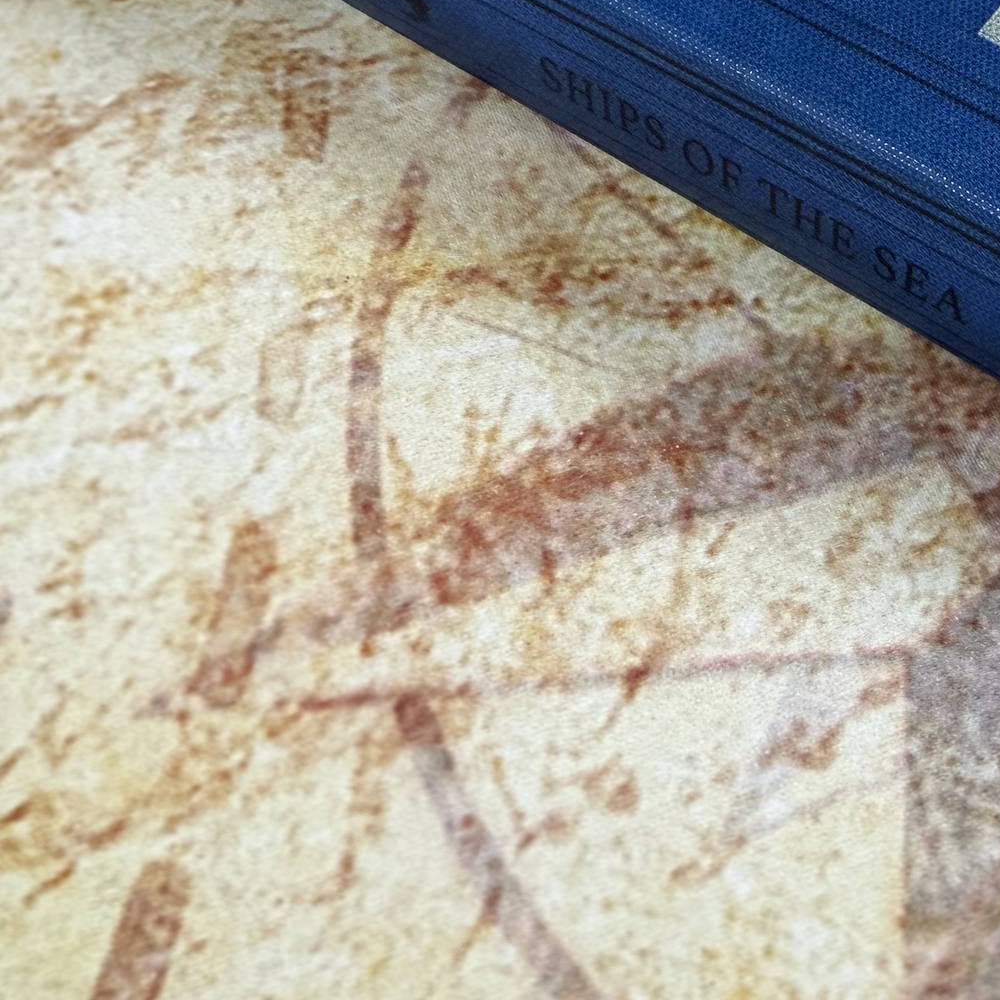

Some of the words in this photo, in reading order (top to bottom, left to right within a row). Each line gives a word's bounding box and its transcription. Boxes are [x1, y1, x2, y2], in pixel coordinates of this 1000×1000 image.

[538, 56, 667, 152] SHIPS
[682, 139, 743, 193] OF
[757, 177, 857, 261] THE
[872, 246, 968, 325] SEA
